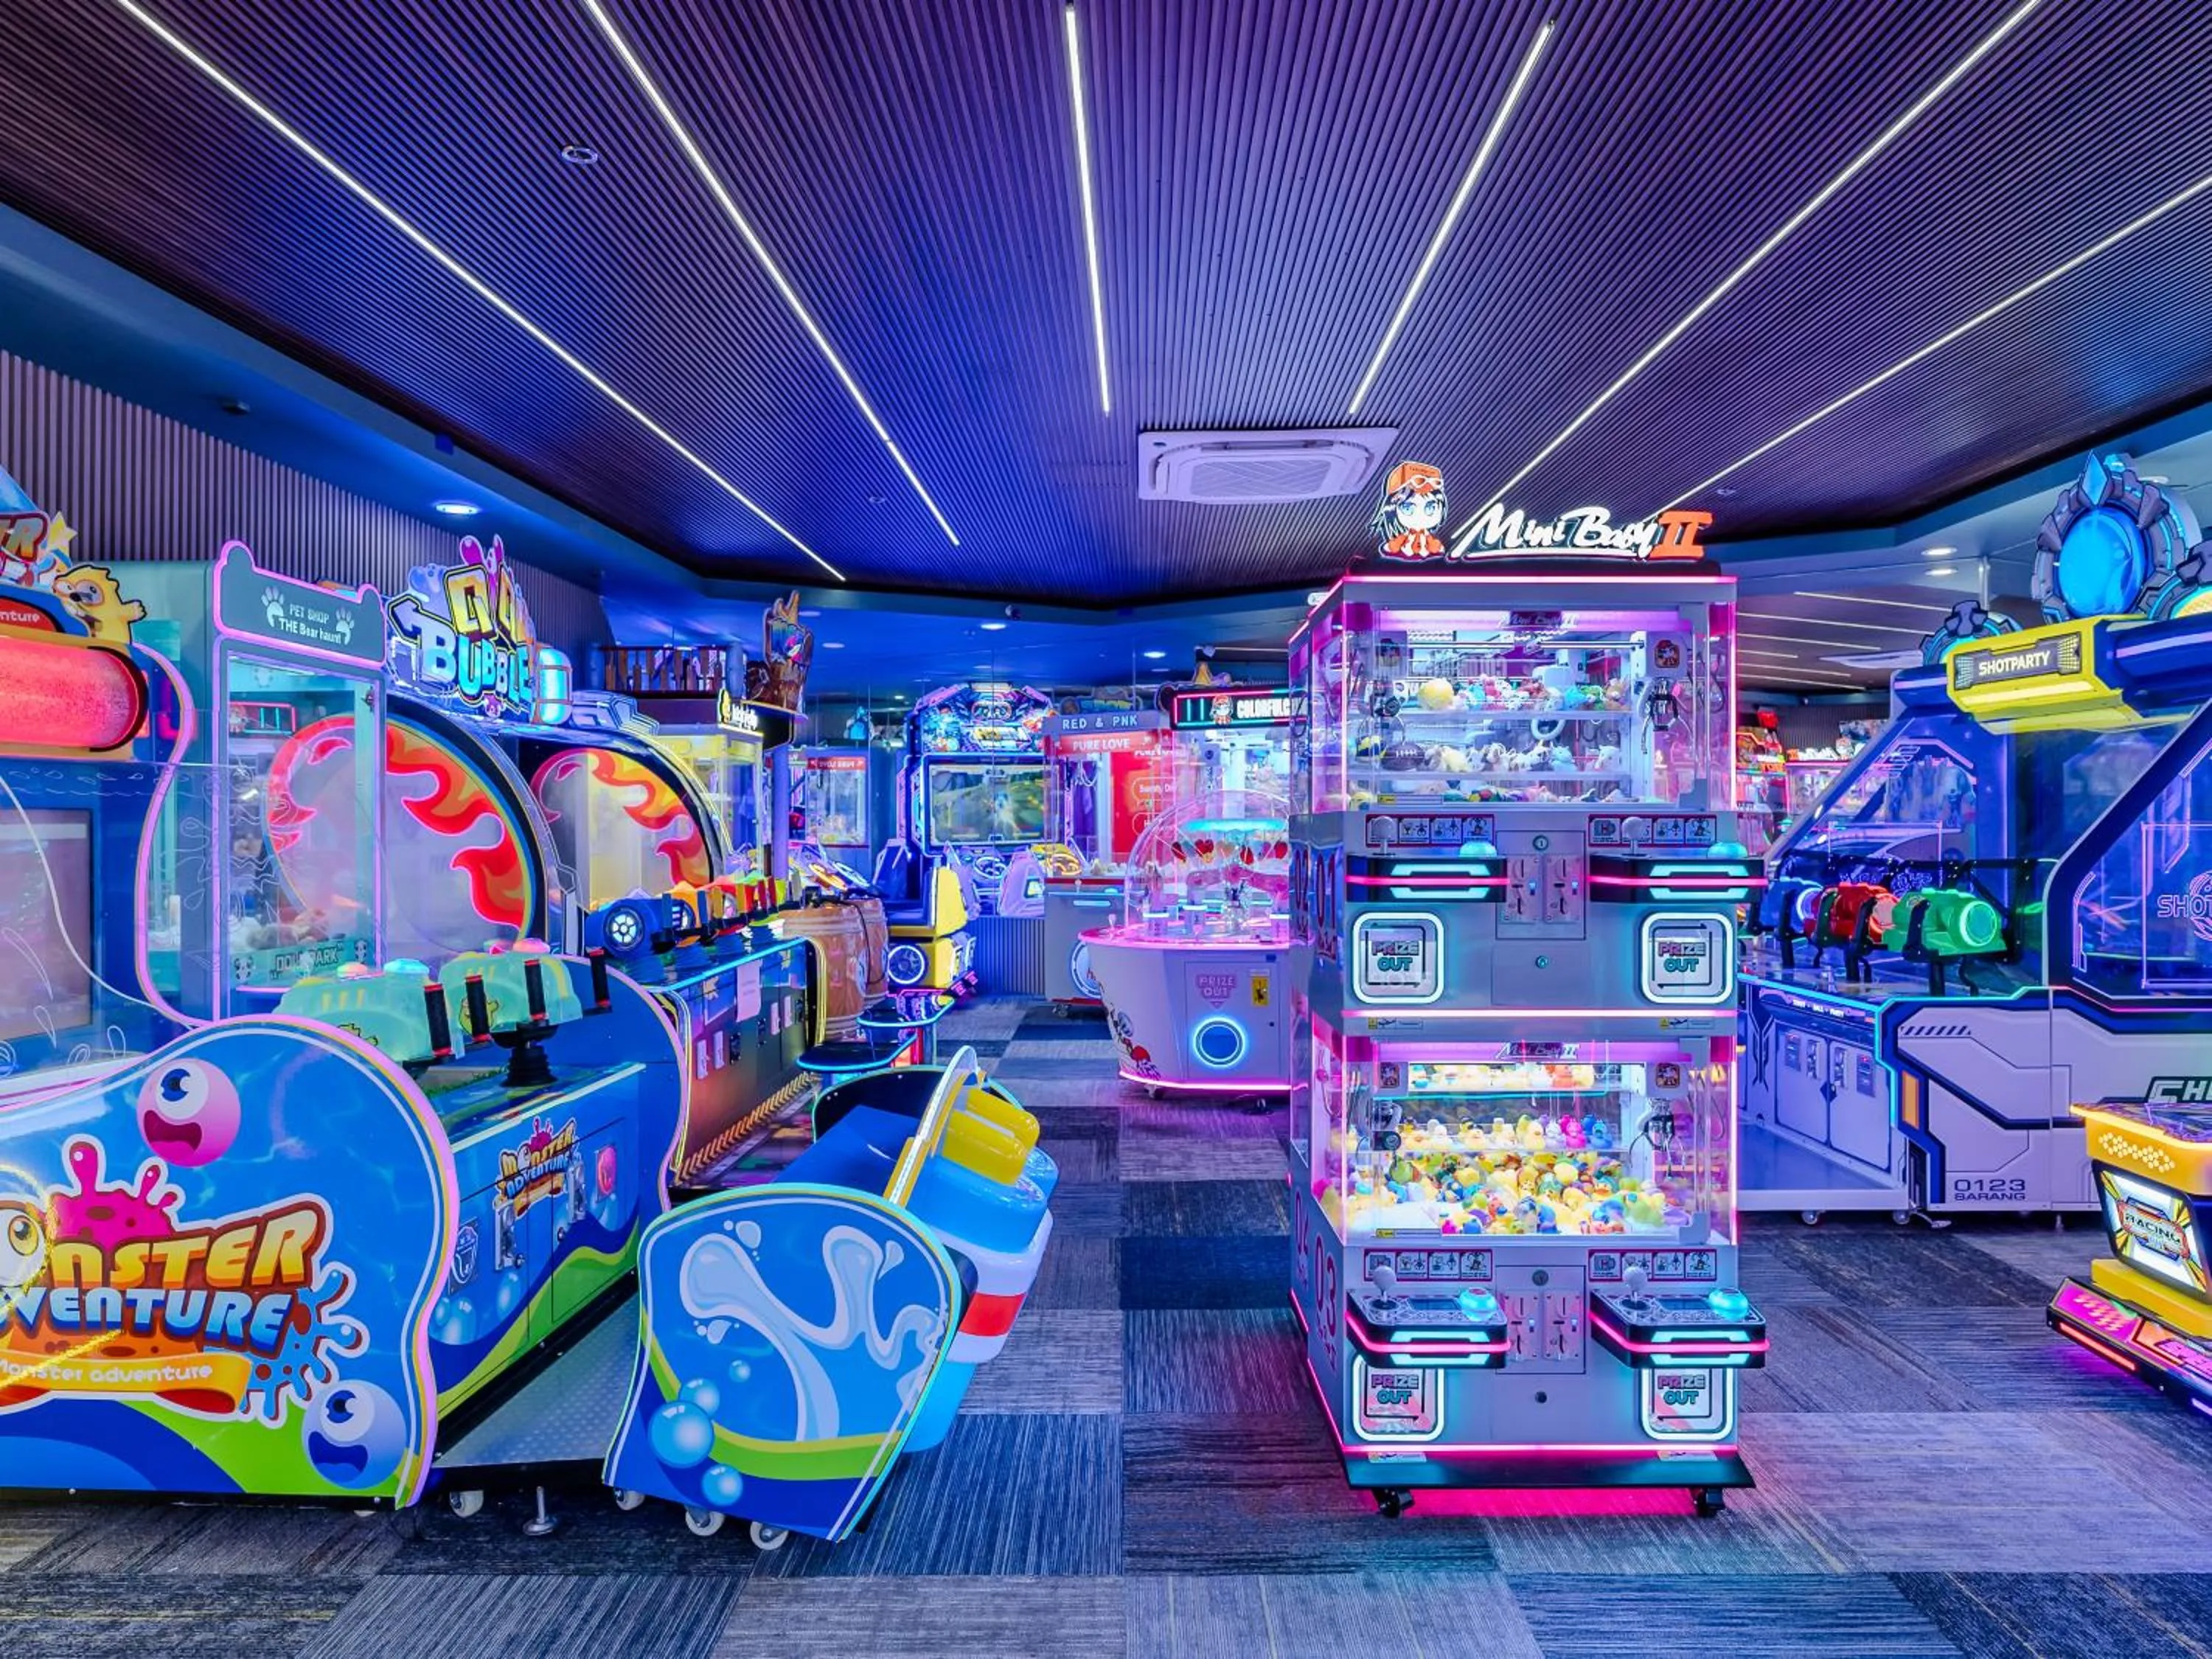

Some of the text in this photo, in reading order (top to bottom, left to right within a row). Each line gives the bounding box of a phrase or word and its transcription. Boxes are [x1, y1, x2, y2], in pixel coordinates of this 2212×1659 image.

[290, 604, 330, 625] PET SHOP
[279, 617, 298, 634] THE
[299, 622, 318, 639] Bear
[1978, 650, 2051, 676] SHOTPARTY
[1062, 718, 1087, 729] RED
[1096, 717, 1104, 728] &
[1073, 738, 1130, 751] PURE LOVE
[1372, 941, 1419, 956] PRIZE
[1658, 942, 1706, 957] PRIZE
[1377, 957, 1413, 972] OUT
[1663, 958, 1699, 973] OUT
[1199, 976, 1234, 987] PRIZE
[1203, 987, 1229, 996] OUT
[2148, 1079, 2212, 1104] CH
[1954, 1179, 2025, 1192] 0123
[89, 1364, 213, 1383] adventure
[1371, 1374, 1419, 1389] PRIZE
[1658, 1375, 1705, 1390] PRIZE
[1377, 1390, 1412, 1404] OUT
[1663, 1390, 1699, 1405] OUT
